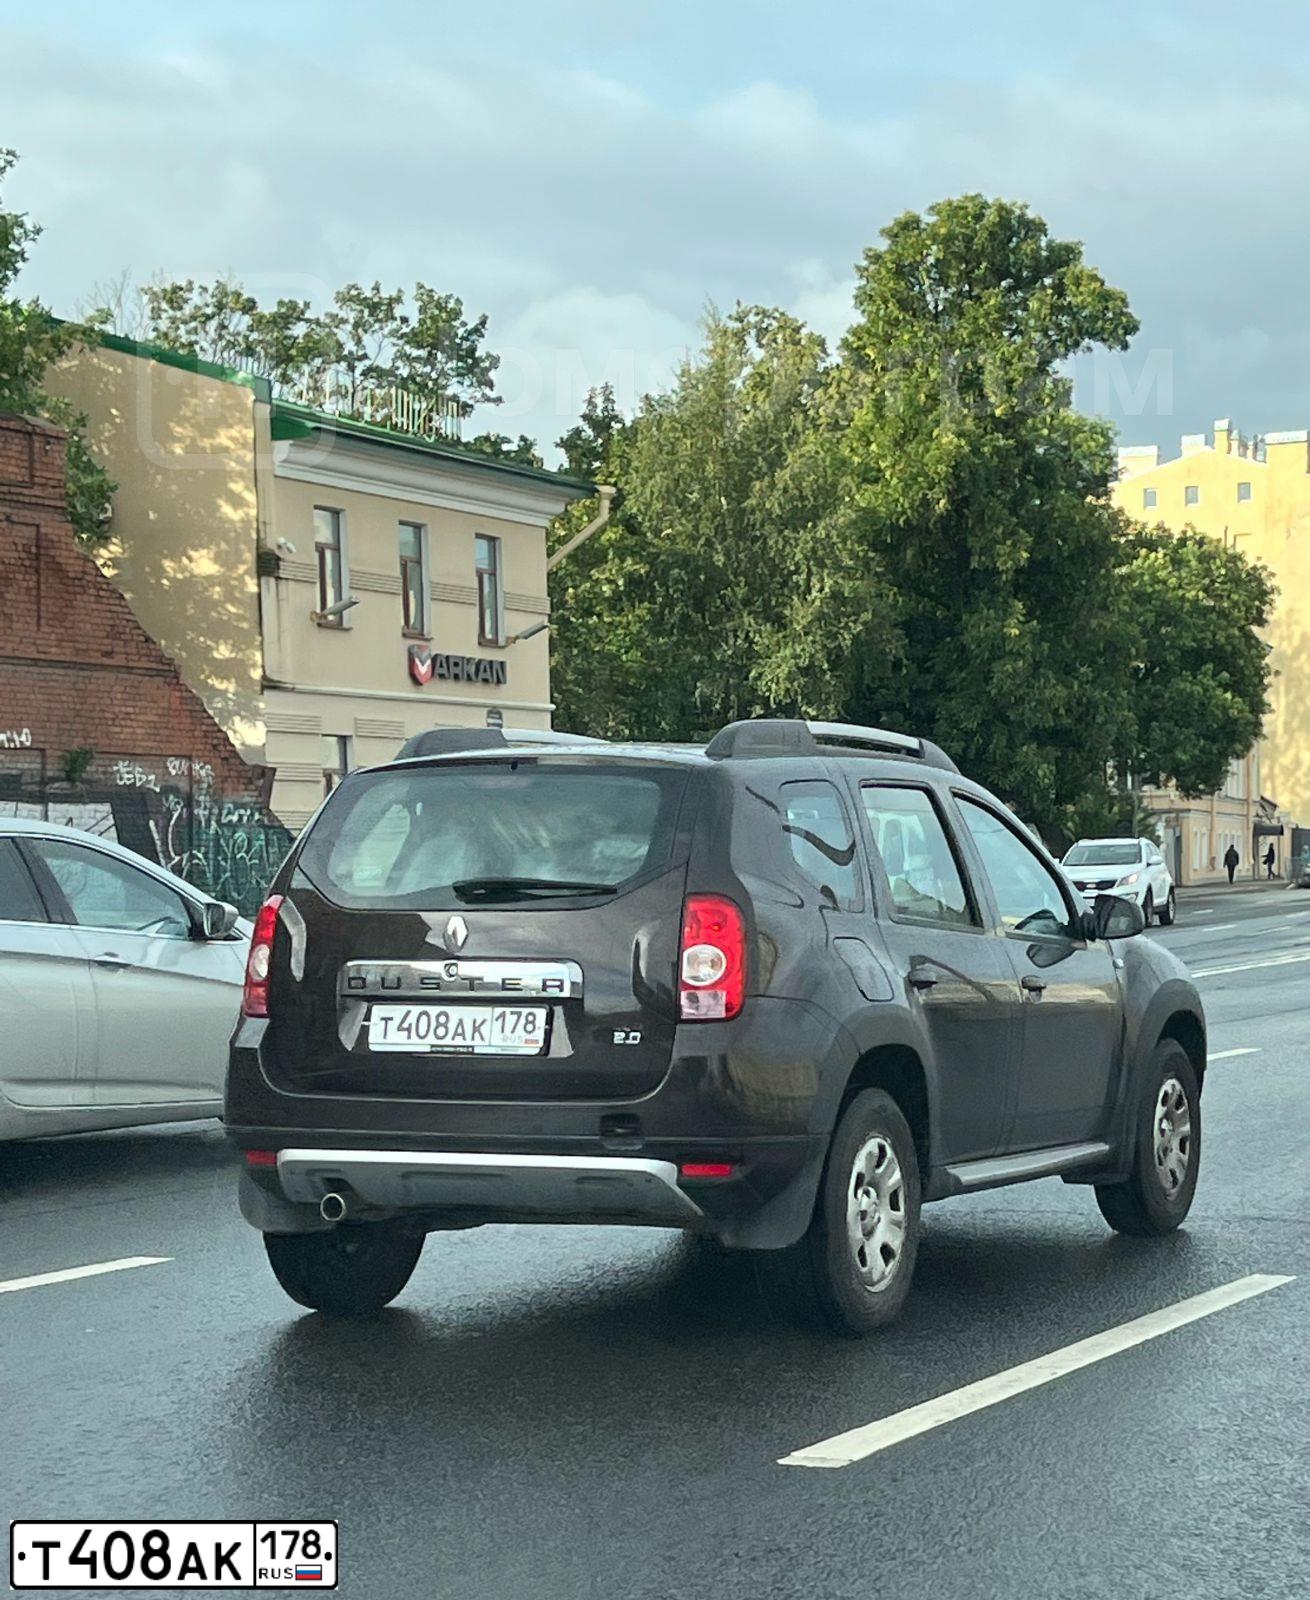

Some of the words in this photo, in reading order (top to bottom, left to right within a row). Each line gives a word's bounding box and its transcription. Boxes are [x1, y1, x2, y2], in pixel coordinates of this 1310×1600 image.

[432, 653, 507, 684] ARKAN
[347, 976, 565, 993] DUSTER
[380, 1009, 487, 1042] T408AK
[494, 1010, 537, 1035] 178
[613, 1031, 641, 1044] 2.0
